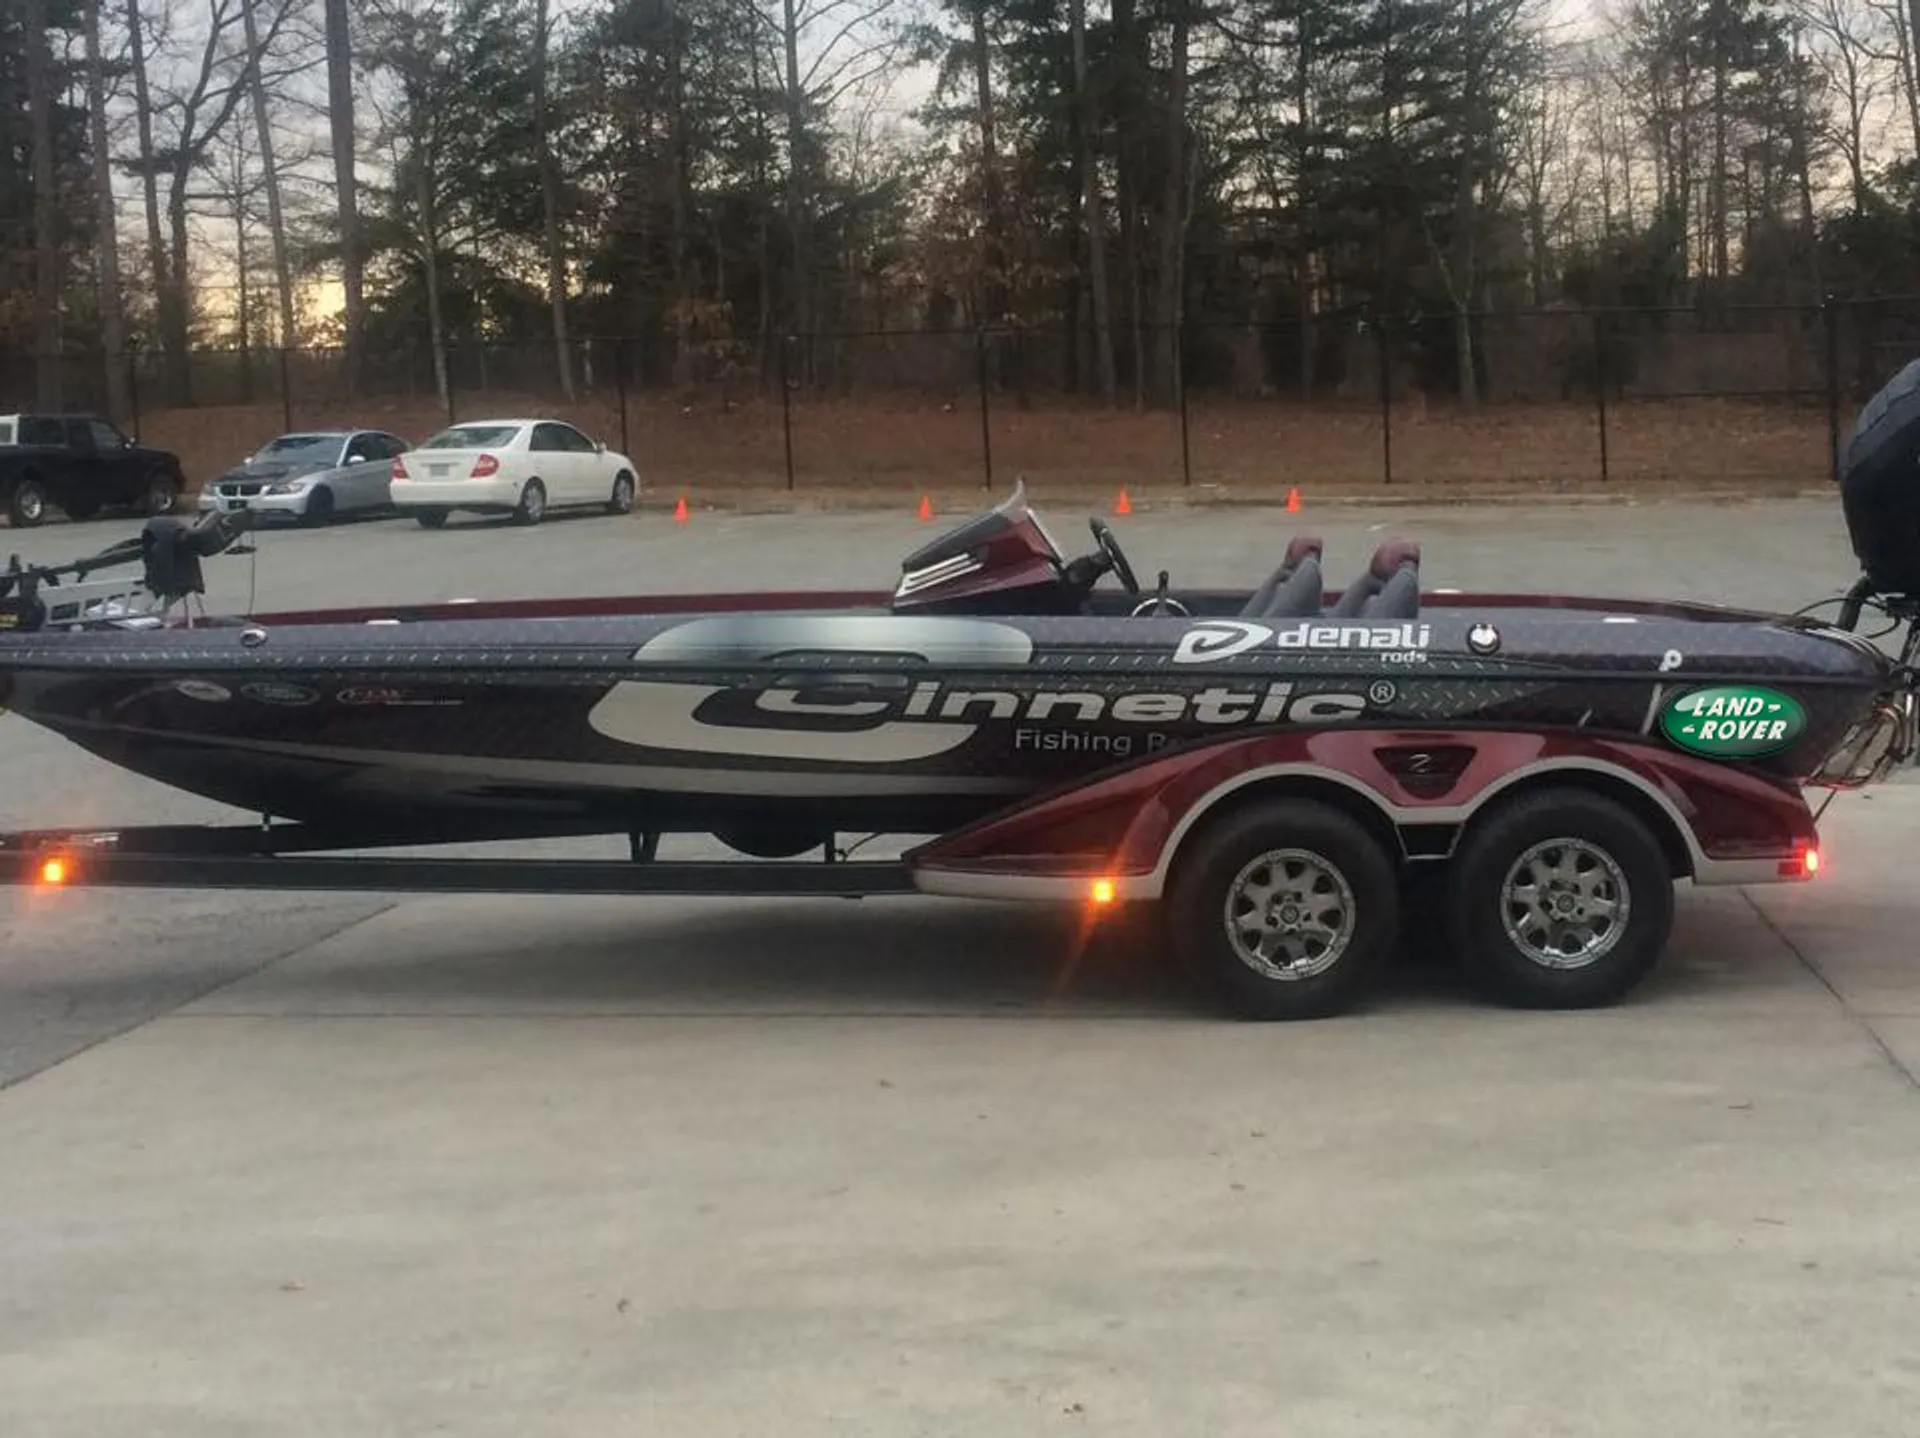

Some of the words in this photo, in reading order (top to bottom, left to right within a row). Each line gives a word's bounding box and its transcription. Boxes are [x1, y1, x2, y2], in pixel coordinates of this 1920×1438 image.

[1277, 623, 1431, 649] denali
[1380, 650, 1428, 664] rods
[1014, 728, 1132, 755] Fishing
